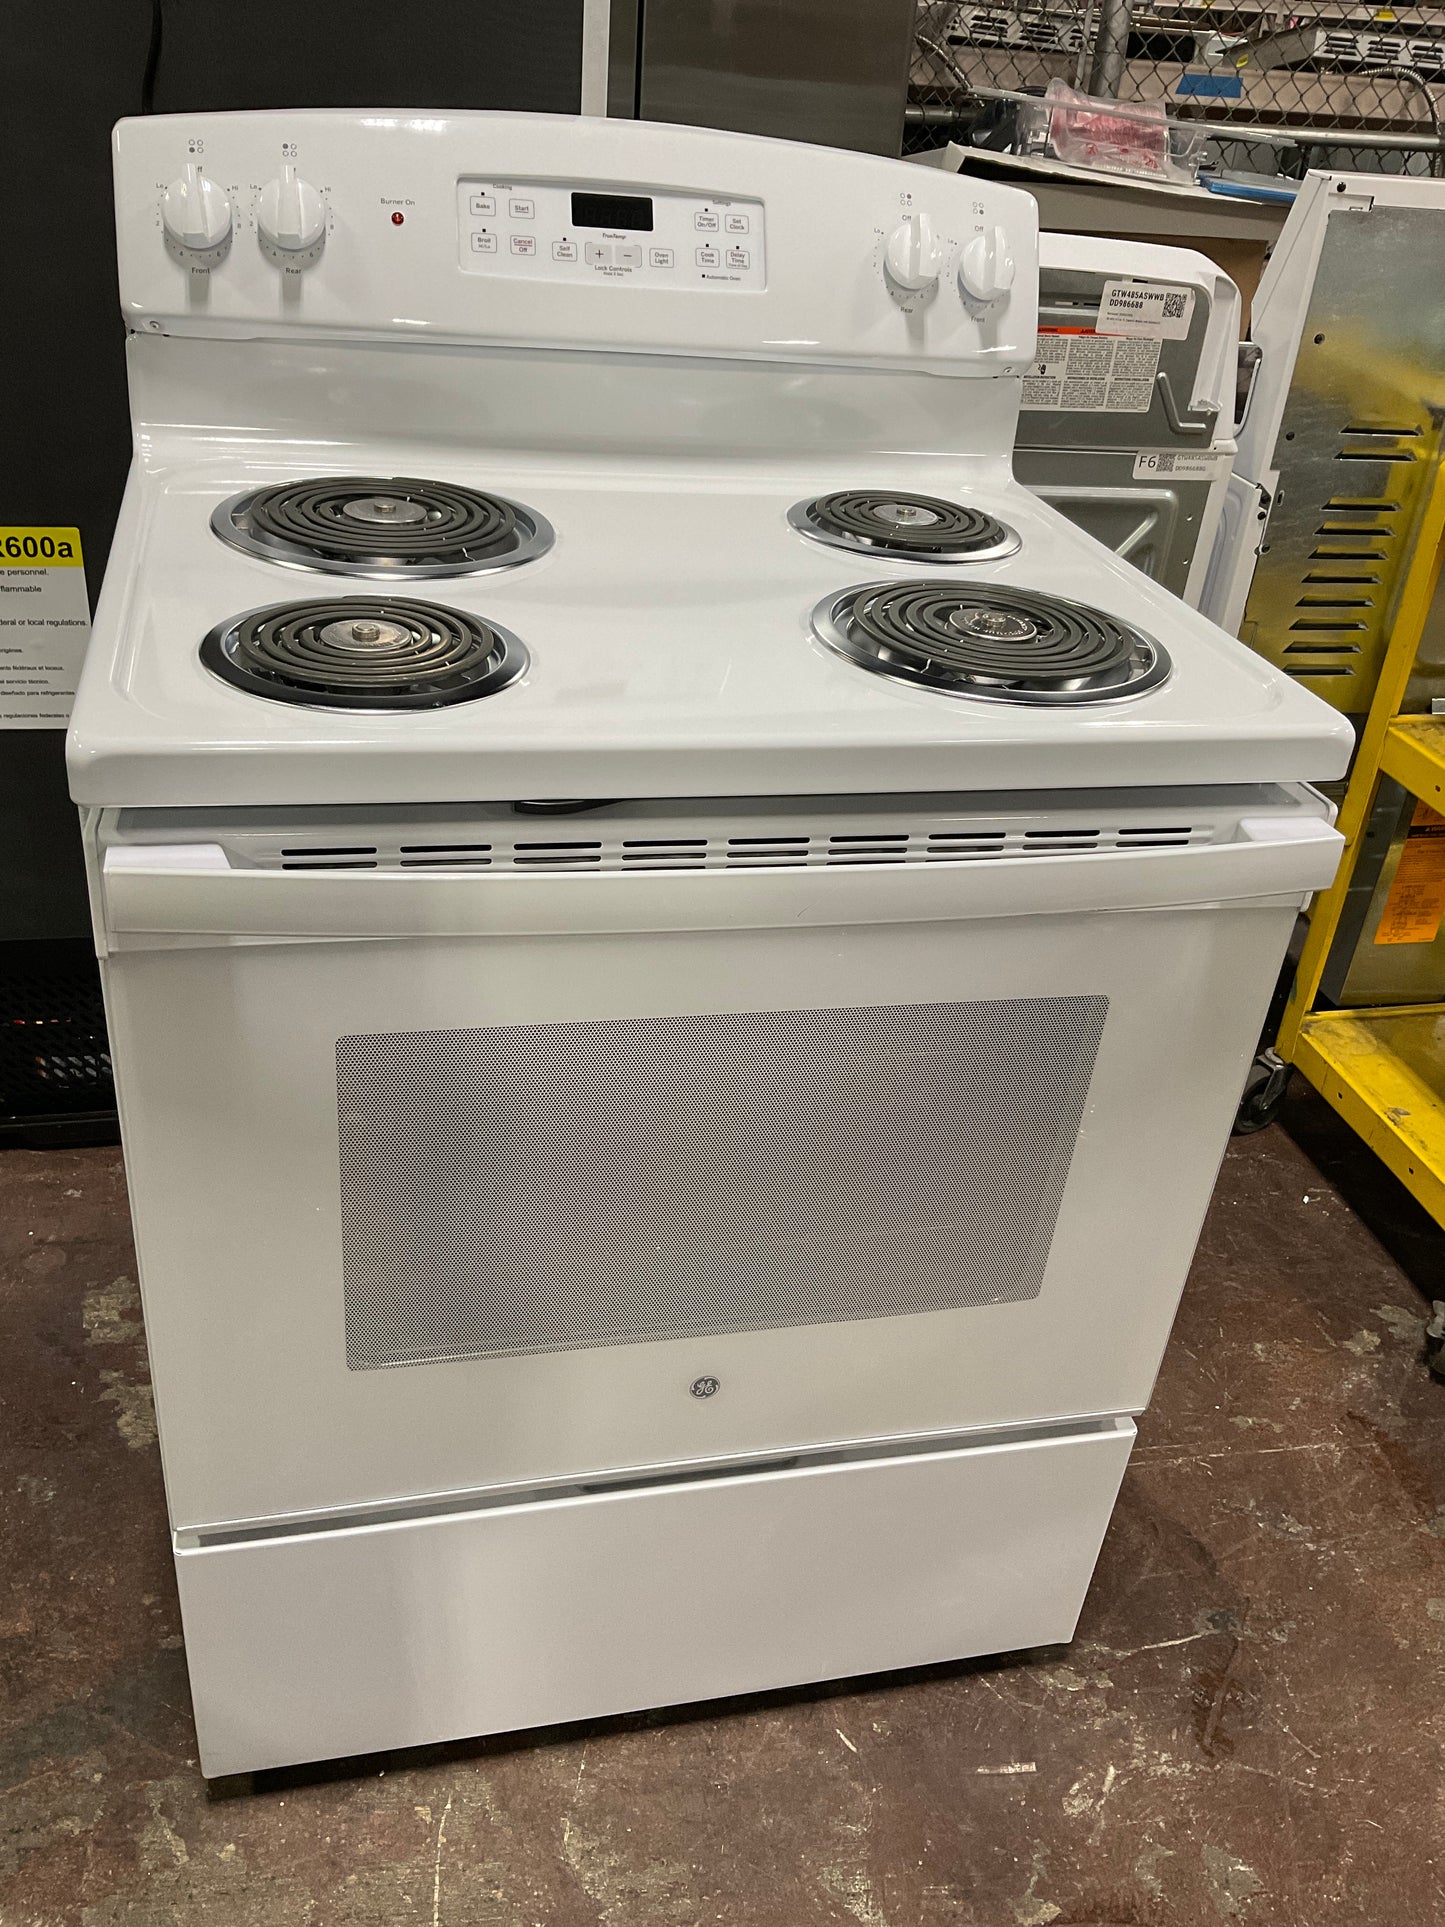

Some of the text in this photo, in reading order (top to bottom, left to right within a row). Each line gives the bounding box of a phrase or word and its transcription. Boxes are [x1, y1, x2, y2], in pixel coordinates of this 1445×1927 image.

[609, 265, 633, 273] Controls
[1138, 455, 1157, 469] F6
[0, 536, 74, 558] 600a
[0, 585, 42, 593] flammable
[46, 619, 88, 627] regulations.
